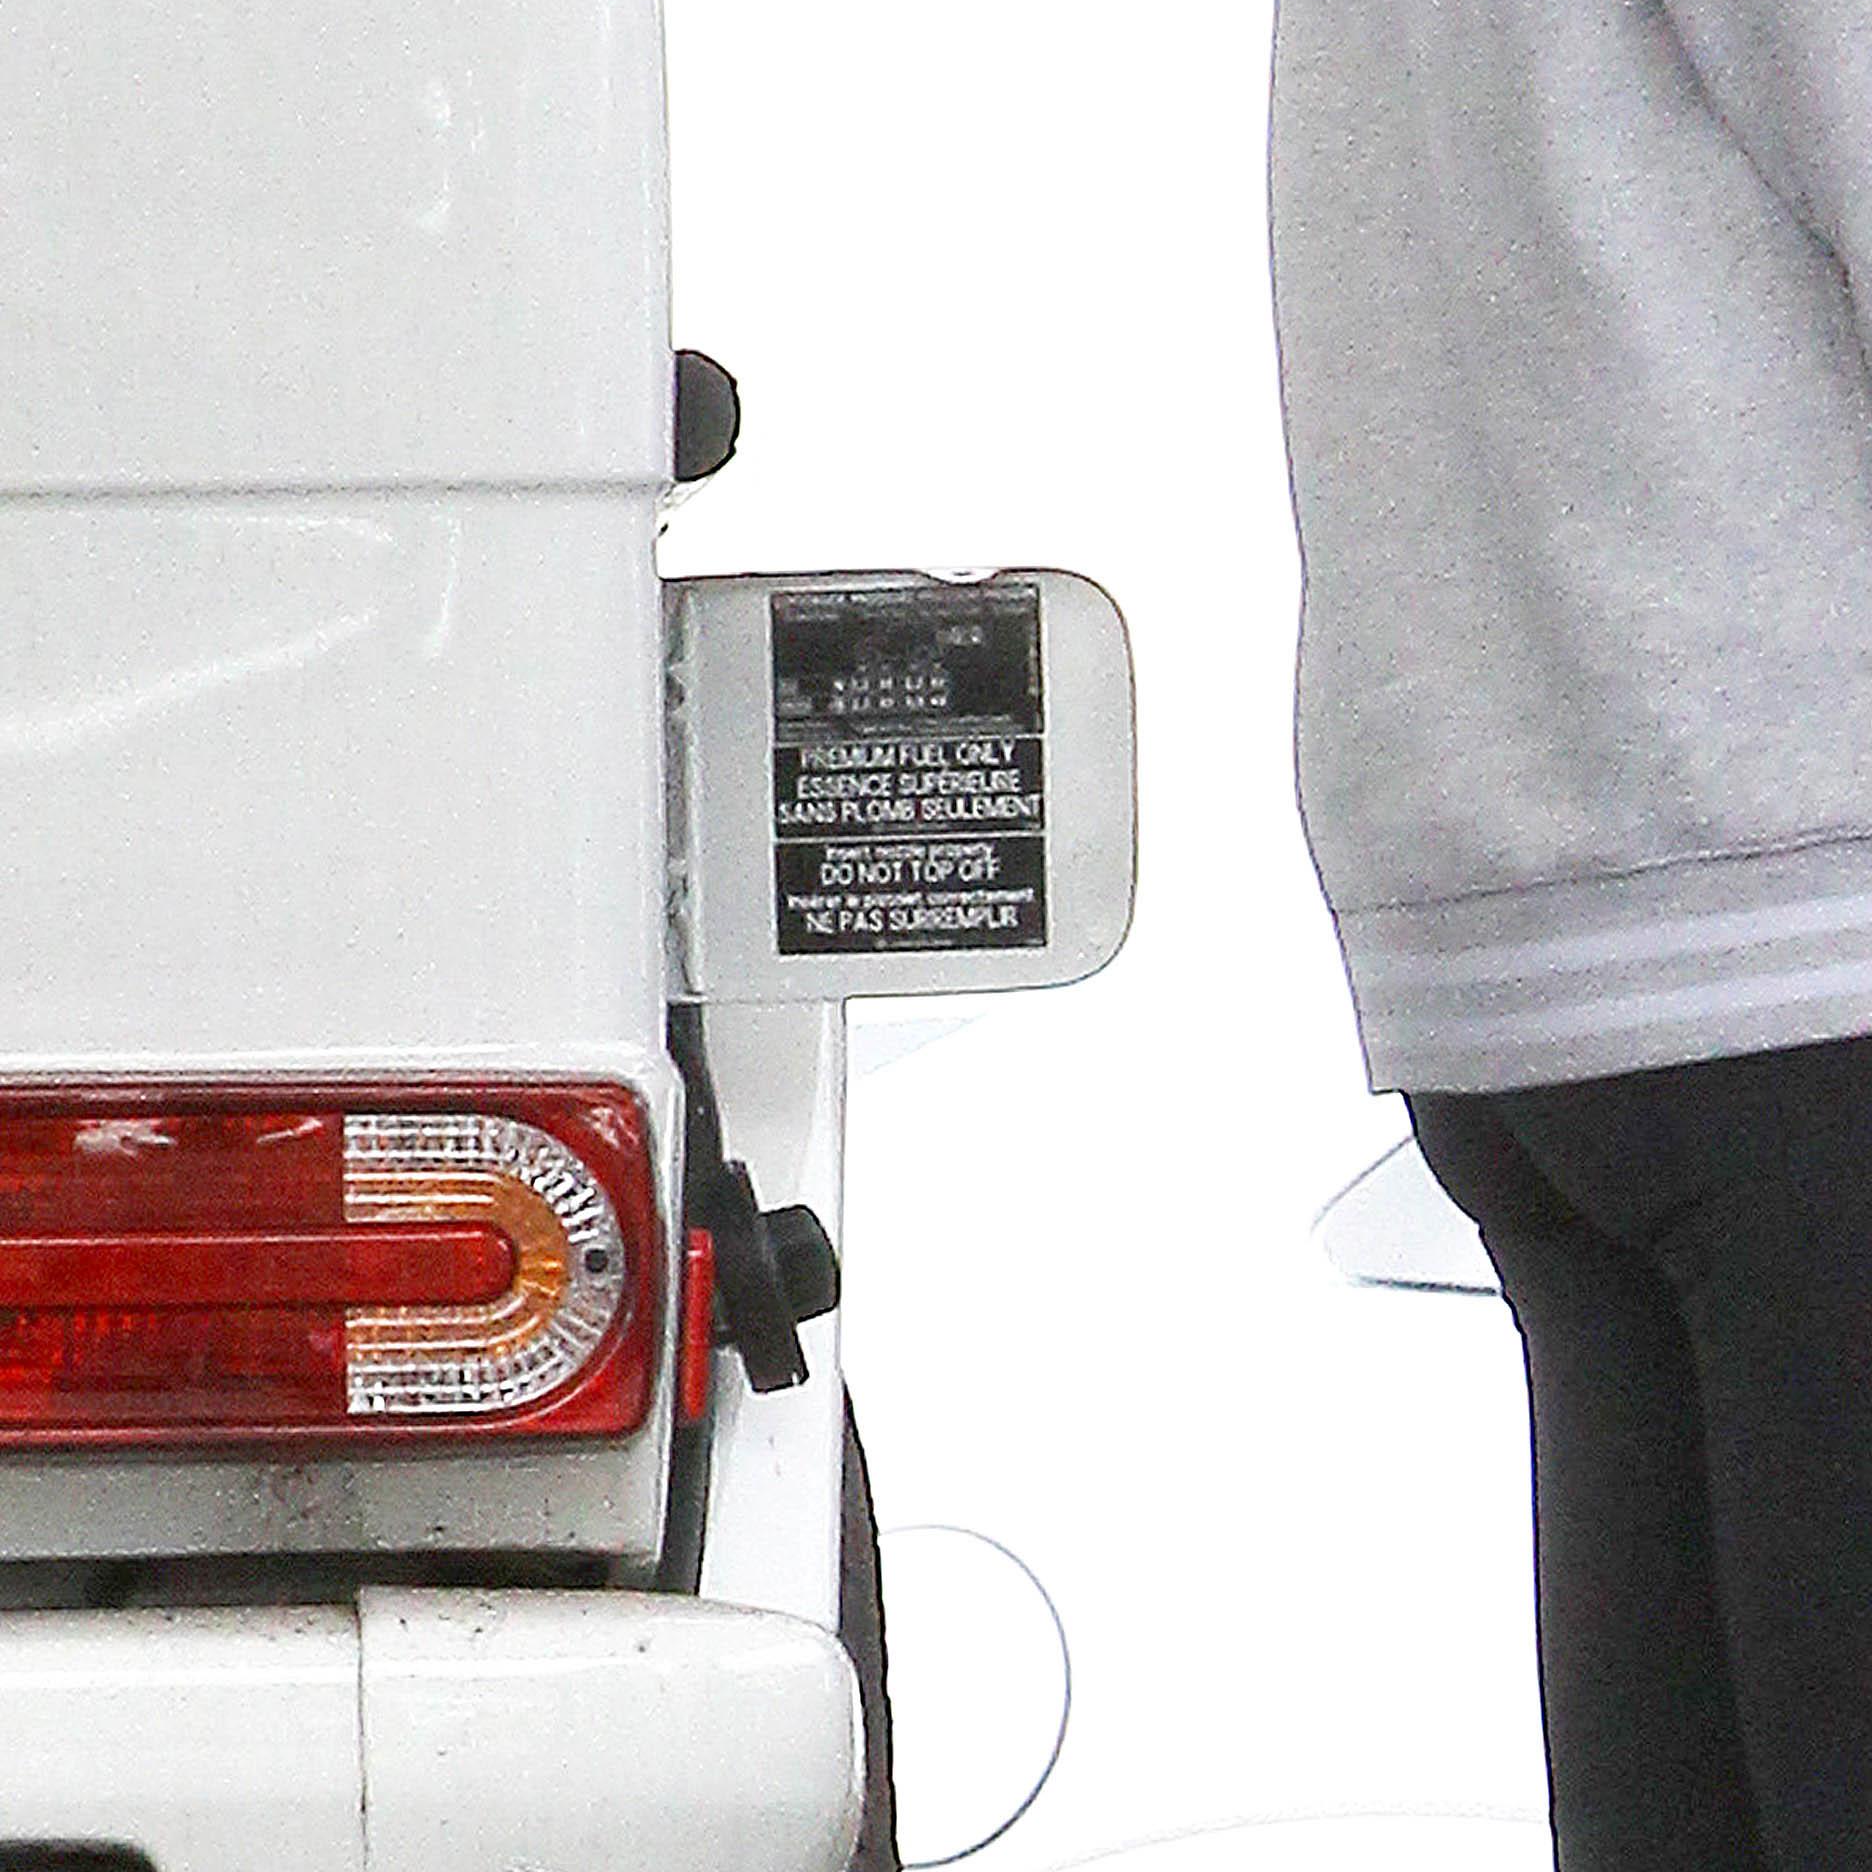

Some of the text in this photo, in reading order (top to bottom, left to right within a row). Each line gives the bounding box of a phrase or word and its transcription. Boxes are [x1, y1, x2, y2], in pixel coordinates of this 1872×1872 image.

[801, 738, 1014, 769] PREMIUM FUEL ONLY
[797, 774, 892, 799] ESSENCE
[778, 794, 1041, 825] SANS PLOMB SEULEMENT
[820, 856, 1001, 886] DO NOT TOP OFF
[806, 911, 834, 934] NE
[840, 908, 884, 932] PAS
